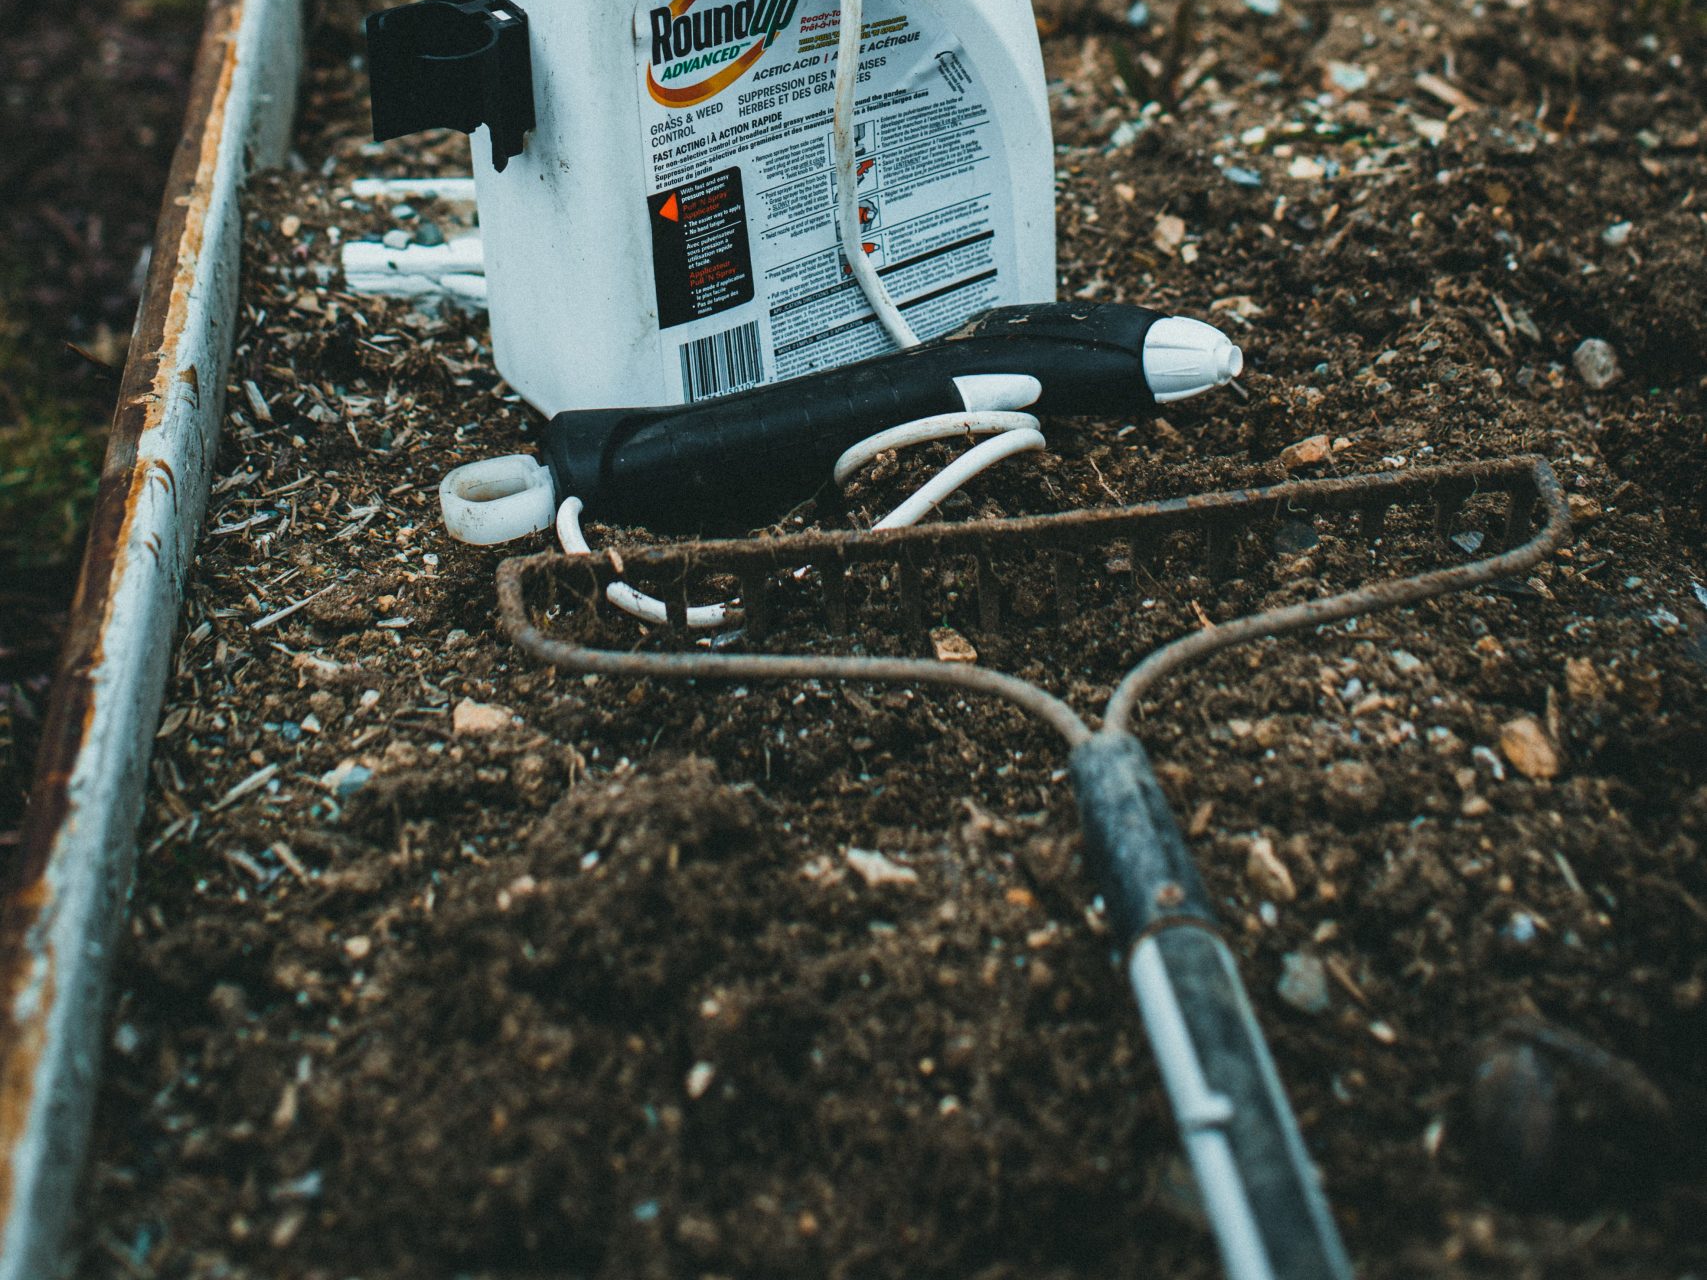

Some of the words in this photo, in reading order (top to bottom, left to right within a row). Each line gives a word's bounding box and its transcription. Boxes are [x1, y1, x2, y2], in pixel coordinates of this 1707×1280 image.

[867, 30, 920, 52] ACÉTIQUE
[752, 62, 791, 82] ACETIC
[792, 54, 820, 70] ACID
[737, 77, 804, 105] SUPPRESSION
[807, 71, 827, 86] DES
[883, 88, 906, 99] garden
[738, 97, 775, 117] HERBES
[778, 93, 789, 106] ET
[792, 87, 811, 102] DES
[866, 100, 890, 111] feuilles
[891, 95, 911, 105] larges
[913, 90, 928, 99] dans
[650, 115, 683, 135] GRASS
[685, 112, 693, 123] &
[695, 101, 723, 120] WEED
[651, 124, 695, 148] CONTROL
[653, 149, 672, 163] FAST
[675, 137, 705, 156] ACTING
[718, 122, 748, 140] ACTION
[751, 111, 782, 129] RAPIDE
[654, 164, 664, 172] For
[665, 149, 707, 168] non-selective
[709, 140, 730, 153] control
[731, 137, 738, 146] of
[739, 127, 768, 143] broadleaf
[770, 122, 781, 133] and
[783, 117, 803, 130] grassy
[805, 109, 826, 121] weeds
[655, 164, 694, 182] Suppression
[737, 145, 749, 154] des
[750, 134, 782, 151] graminées
[783, 130, 790, 138] et
[791, 127, 802, 135] des
[755, 153, 772, 162] Remove
[773, 148, 788, 156] sprayer
[809, 136, 823, 144] carrier
[655, 182, 662, 190] et
[663, 175, 684, 187] autour
[694, 165, 712, 178] jardin
[763, 165, 775, 173] Insert
[680, 186, 693, 196] With
[694, 182, 705, 190] fast
[705, 178, 715, 186] and
[681, 189, 704, 203] pressure
[683, 200, 696, 212] Pull
[683, 202, 720, 220] Applicator
[698, 215, 712, 224] easier
[729, 204, 740, 213] apply
[697, 223, 708, 232] hand
[709, 218, 724, 227] fatigue
[686, 241, 699, 249] Avec
[687, 247, 700, 256] sous
[701, 239, 723, 252] pression
[687, 249, 714, 263] utilisation
[716, 243, 732, 253] rapide
[689, 260, 730, 280] Applicateur
[690, 276, 703, 287] Pull
[702, 284, 714, 292] mode
